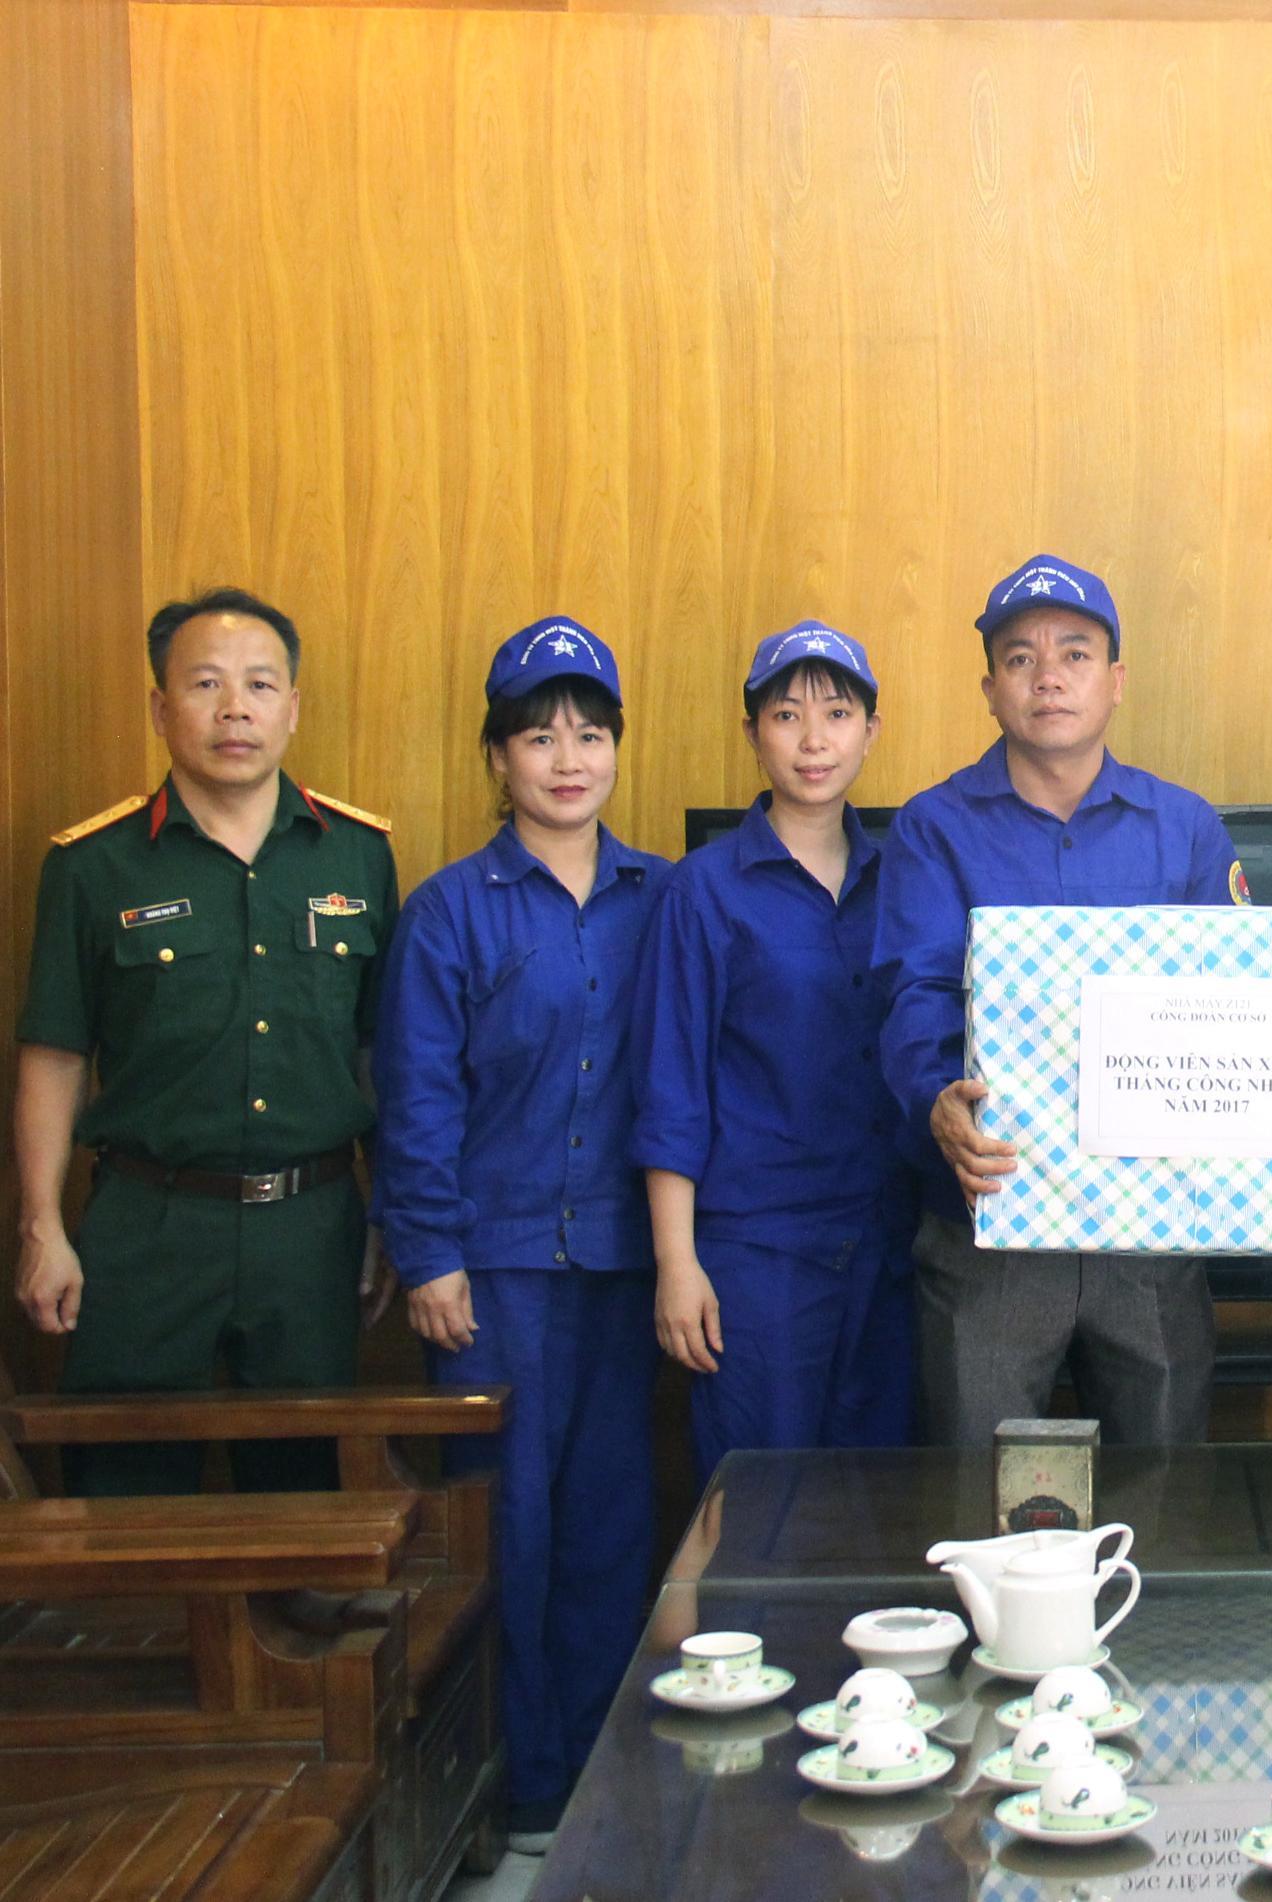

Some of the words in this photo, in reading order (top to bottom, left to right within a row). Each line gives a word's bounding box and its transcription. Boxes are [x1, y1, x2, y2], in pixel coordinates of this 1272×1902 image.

[1150, 1008, 1187, 1022] CÔNG
[1105, 1053, 1160, 1073] ĐỘNG
[1166, 1052, 1211, 1070] VIÊN
[1113, 1073, 1181, 1091] THÁNG
[1186, 1073, 1241, 1092] CÔNG
[1164, 1095, 1208, 1113] NĂM
[1214, 1099, 1250, 1113] 2017
